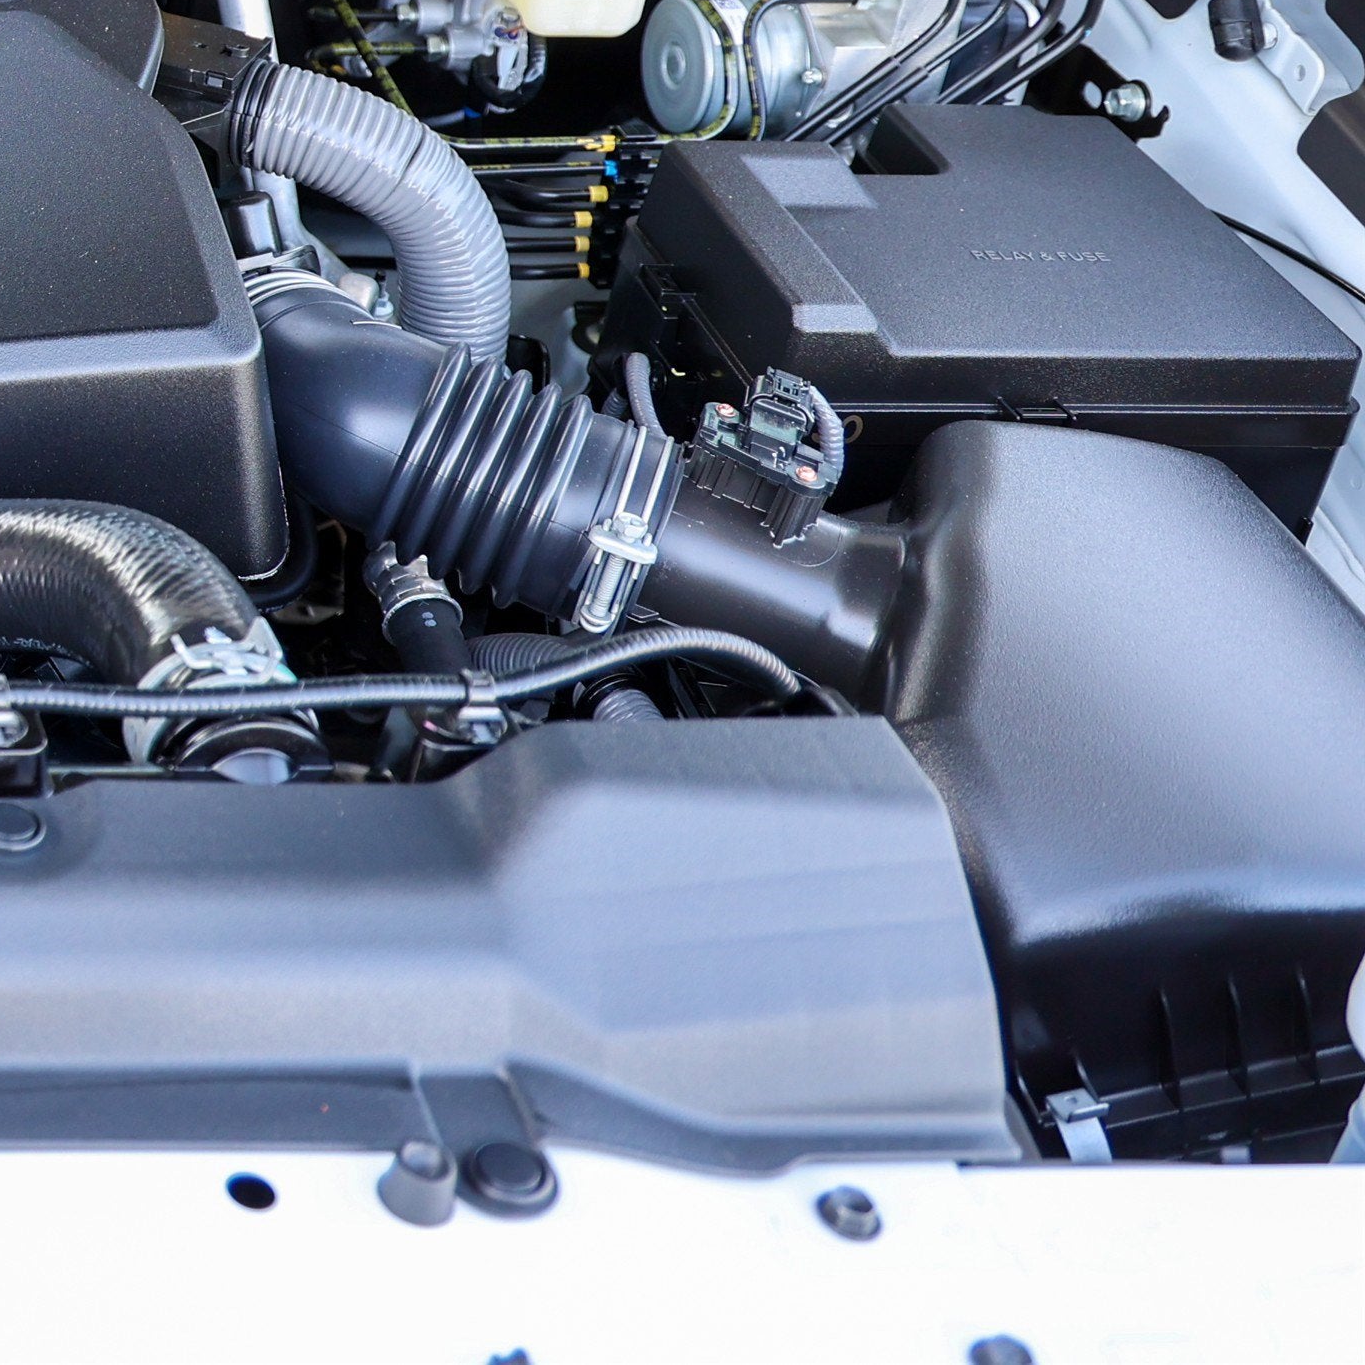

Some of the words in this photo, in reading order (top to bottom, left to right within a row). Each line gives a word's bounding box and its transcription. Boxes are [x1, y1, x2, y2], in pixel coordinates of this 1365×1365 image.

[970, 249, 1035, 262] RELAY
[1039, 250, 1055, 262] &
[1056, 250, 1112, 263] FUSE
